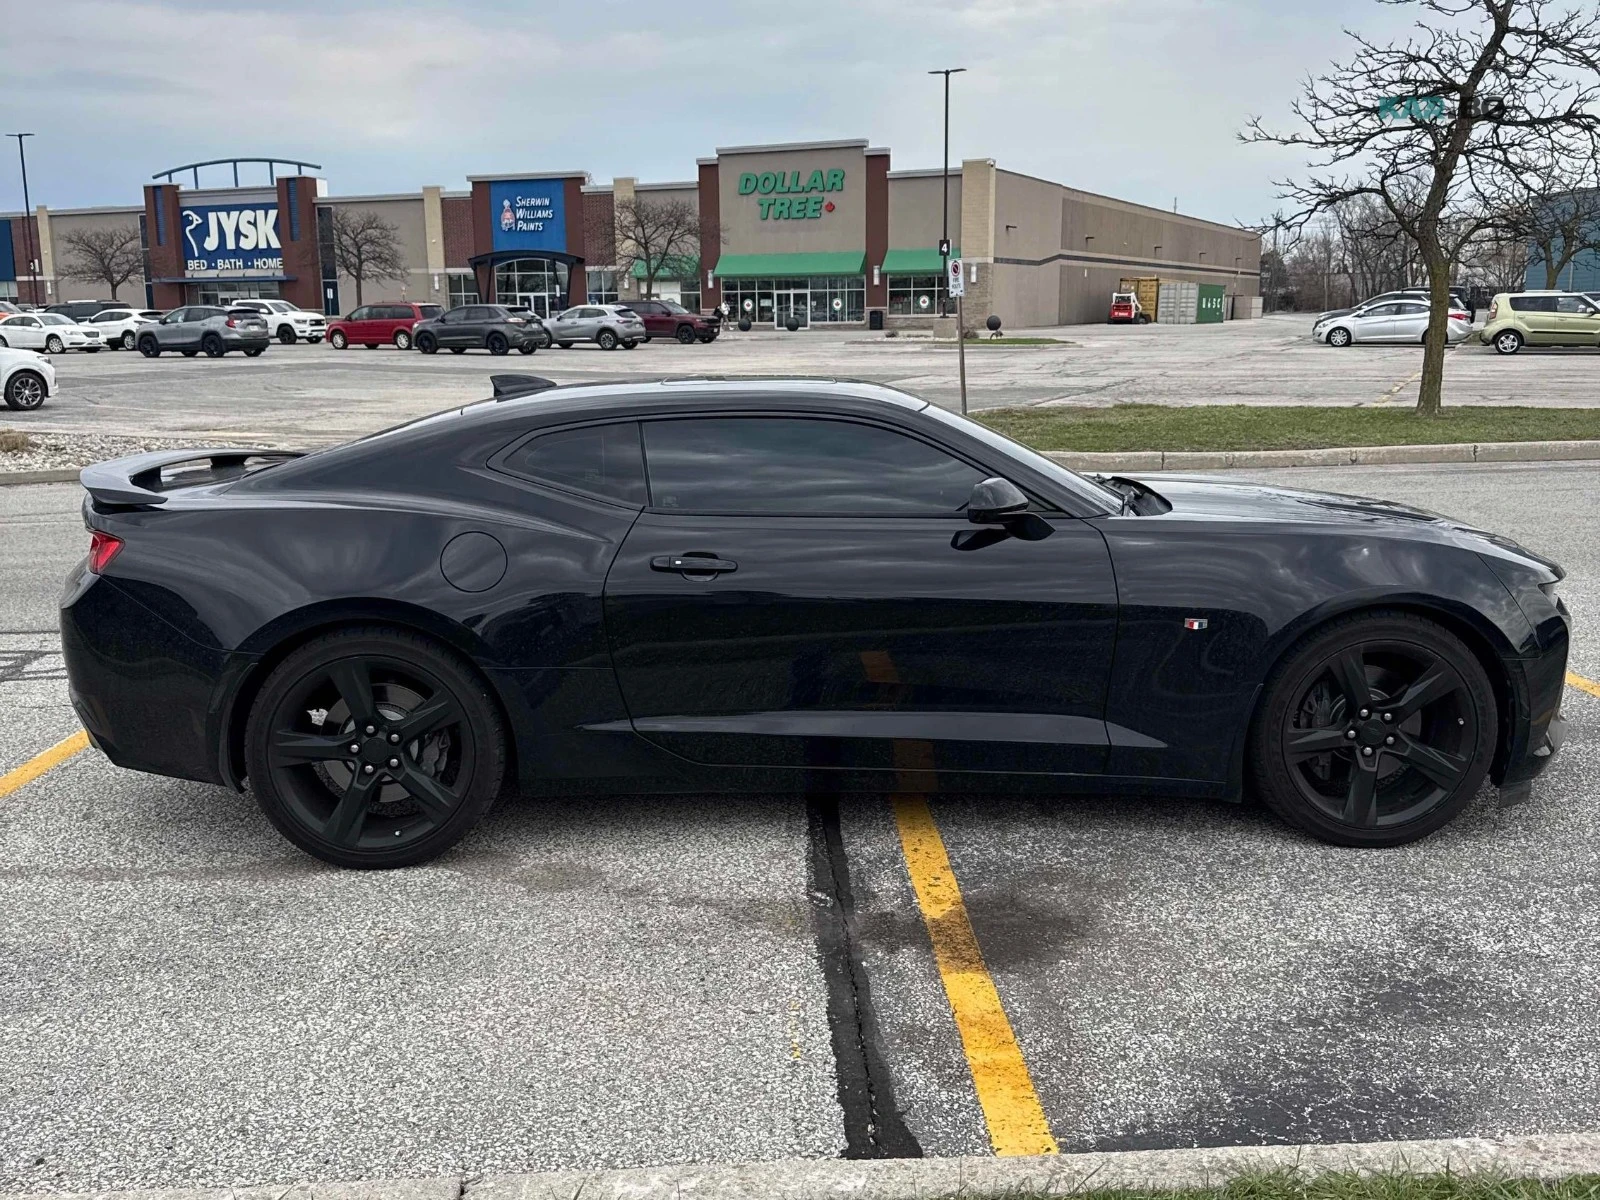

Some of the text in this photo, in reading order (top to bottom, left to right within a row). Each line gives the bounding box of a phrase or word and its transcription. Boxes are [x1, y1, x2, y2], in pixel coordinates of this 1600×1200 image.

[738, 168, 845, 195] DOLLAR
[516, 196, 550, 207] SHERWIN
[516, 208, 553, 219] WILLIAMS
[758, 196, 824, 220] TREE
[203, 209, 282, 251] JYSK
[517, 221, 543, 231] PAINTS
[941, 243, 948, 253] 4
[187, 258, 283, 270] BED BATH HOME
